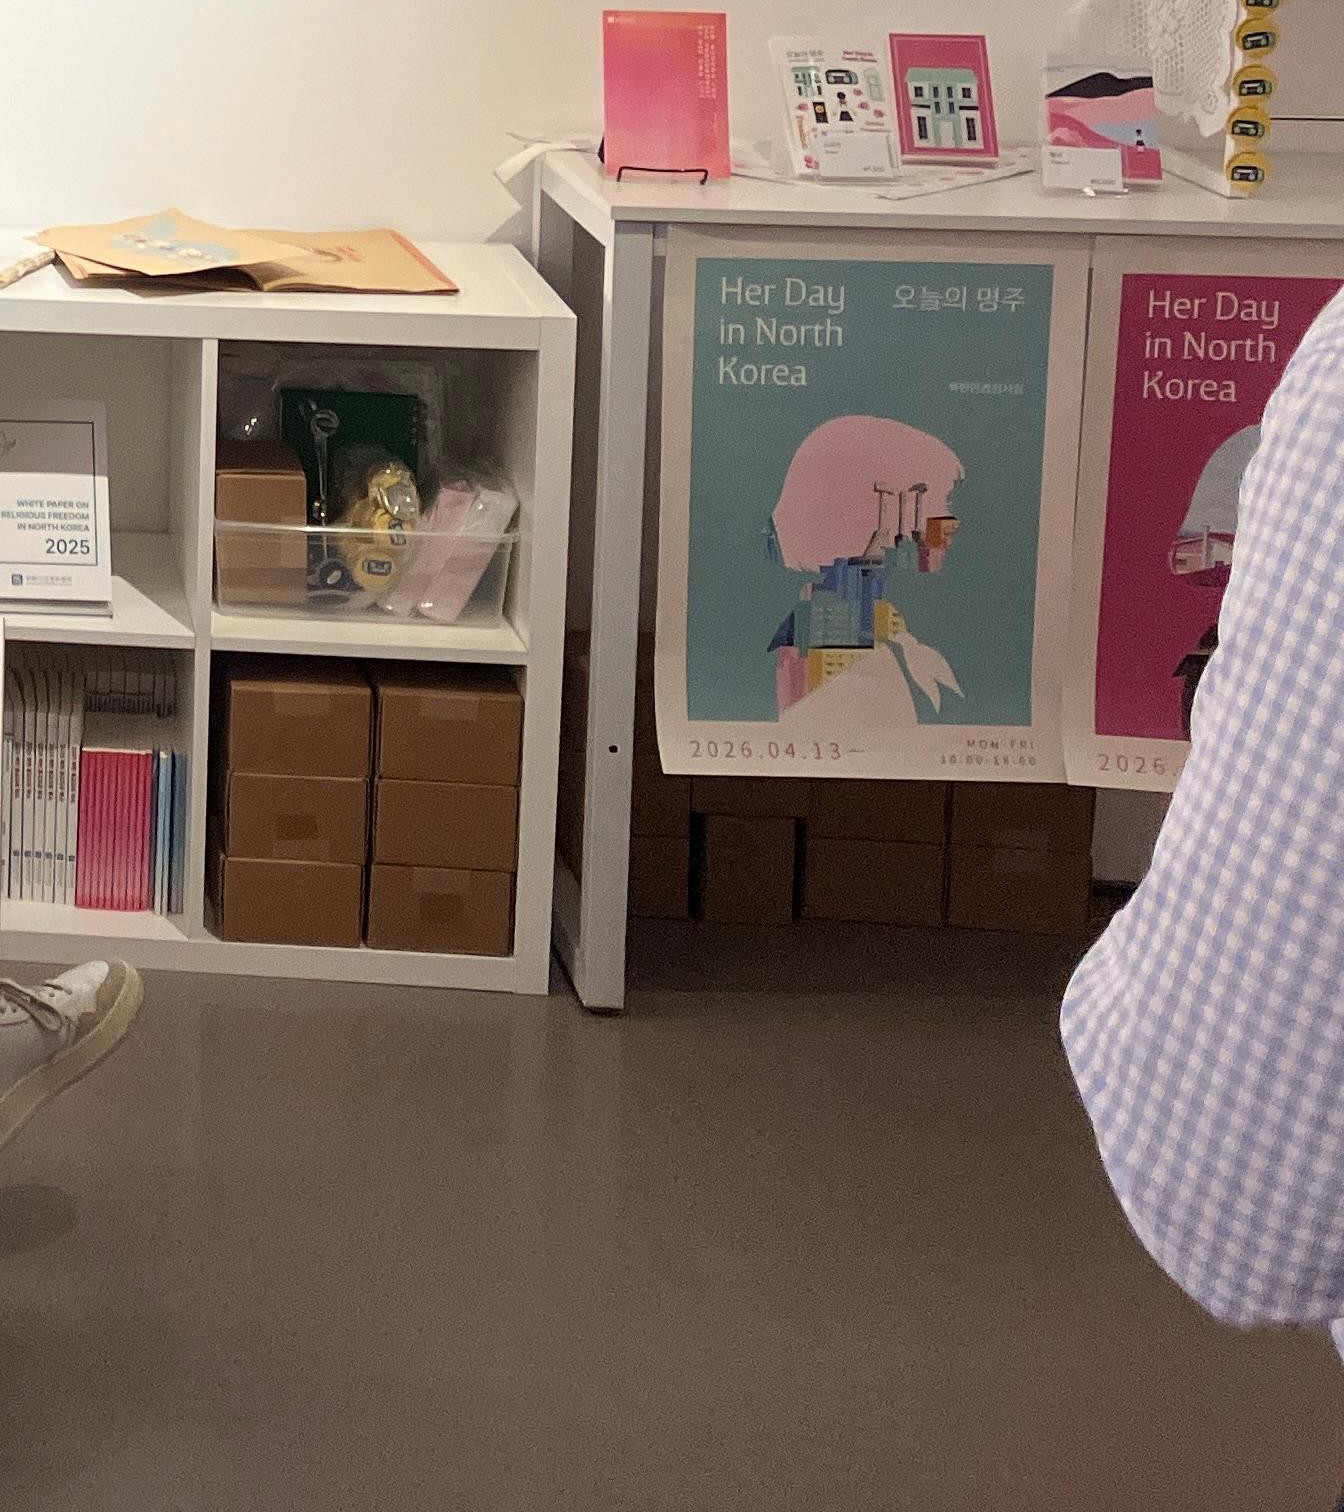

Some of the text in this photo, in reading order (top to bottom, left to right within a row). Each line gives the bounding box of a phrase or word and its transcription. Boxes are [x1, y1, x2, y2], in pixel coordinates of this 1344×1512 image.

[720, 275, 846, 315] Her Day
[891, 285, 1026, 313] 오늘의 명주
[1148, 289, 1280, 329] Her Day
[719, 316, 844, 347] in North
[1144, 330, 1276, 364] in North
[718, 355, 808, 387] Korea
[1142, 369, 1238, 403] Korea
[1, 510, 90, 521] RELIGIOUS FREEDOM
[16, 499, 90, 510] WHITE PAPER ON
[16, 522, 90, 533] IN NORTH KOREA
[45, 537, 91, 556] 2025
